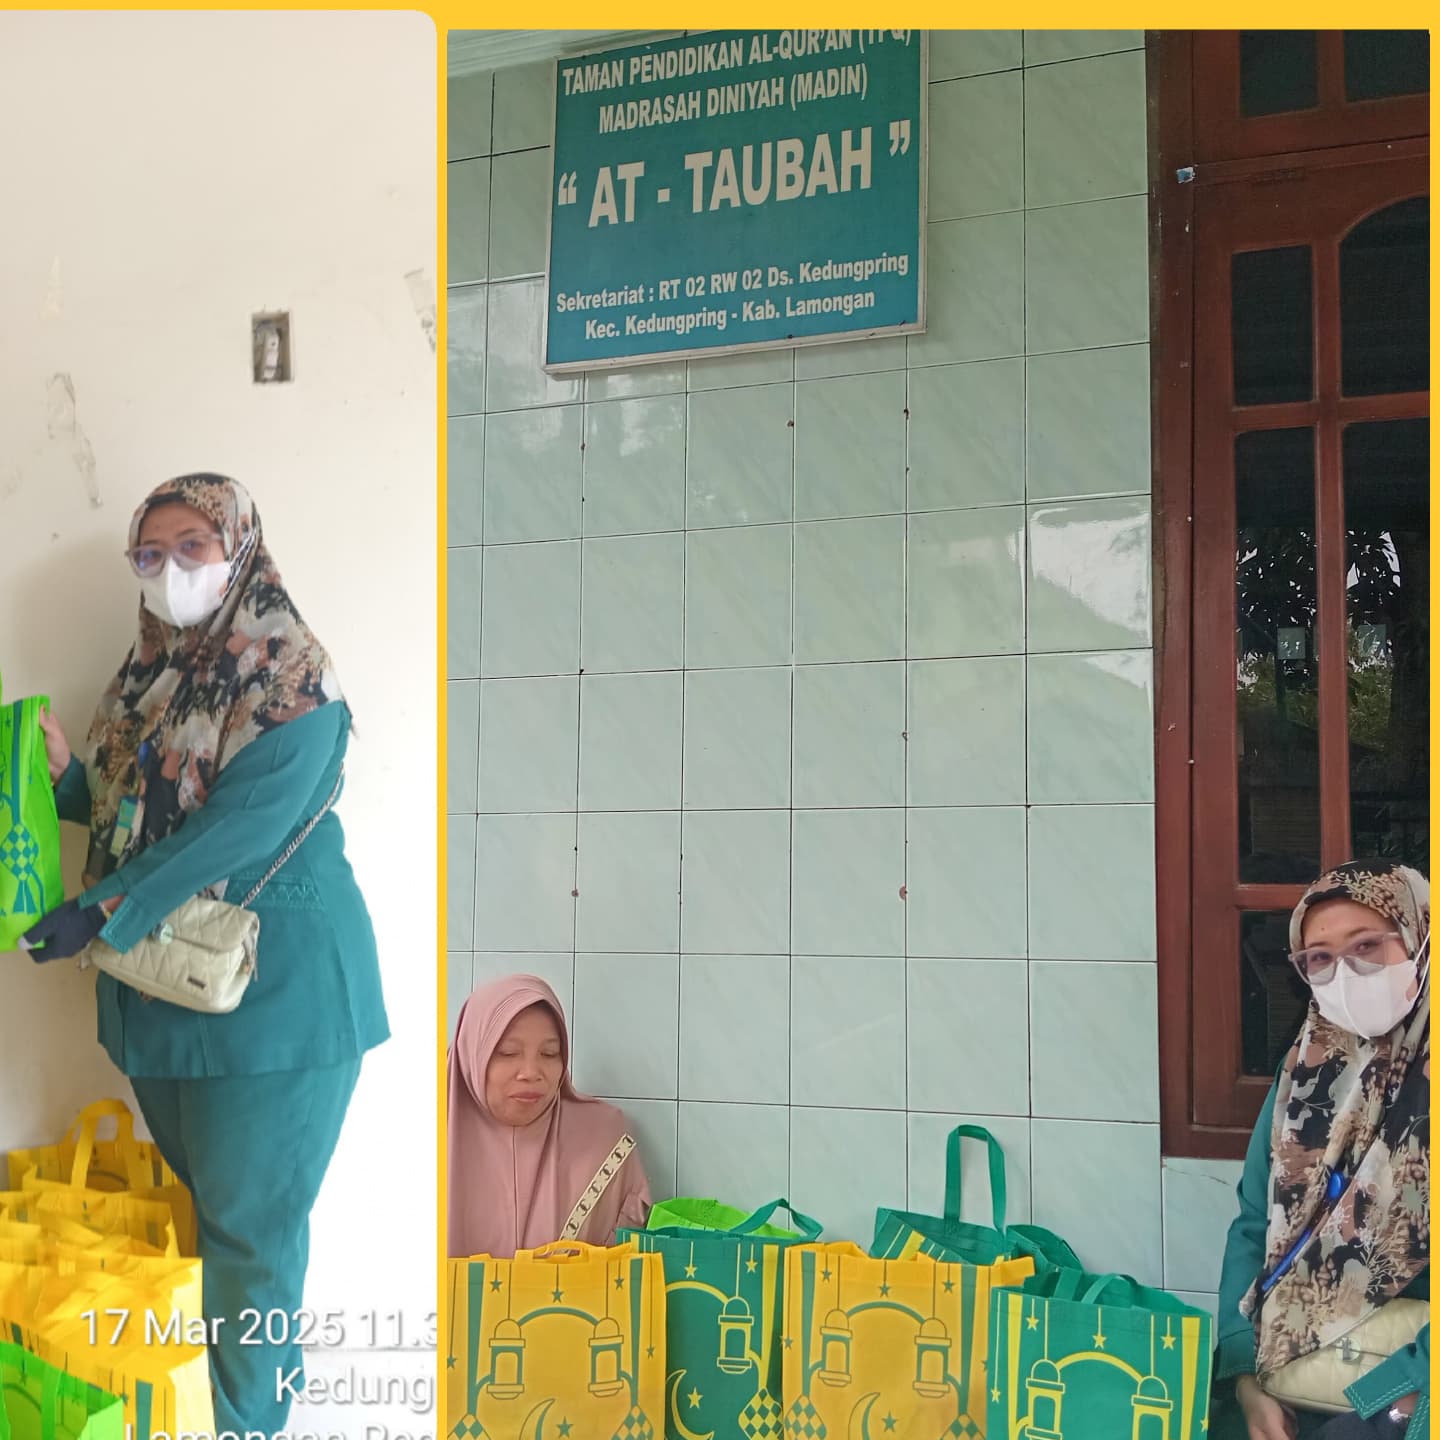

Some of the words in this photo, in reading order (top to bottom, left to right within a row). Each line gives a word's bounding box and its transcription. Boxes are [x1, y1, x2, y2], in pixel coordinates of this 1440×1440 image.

[562, 61, 624, 96] TAMAN
[629, 38, 744, 86] PENDIDIKAN
[599, 90, 701, 134] MADRASAH
[707, 76, 785, 117] DINIYAH
[790, 62, 868, 112] (MADIN)
[588, 160, 645, 228] AT
[684, 126, 872, 214] TAUBAH
[556, 284, 646, 313] Sekretariat
[659, 278, 681, 301] RT
[685, 275, 706, 298] 02
[710, 271, 737, 295] RW
[742, 268, 763, 291] 02
[768, 264, 794, 288] Ds.
[799, 252, 909, 285] Kedungpring
[585, 318, 620, 340] Kec.
[625, 306, 727, 336] Kedungpring
[742, 297, 781, 322] Kab.
[785, 290, 875, 317] Lamongan
